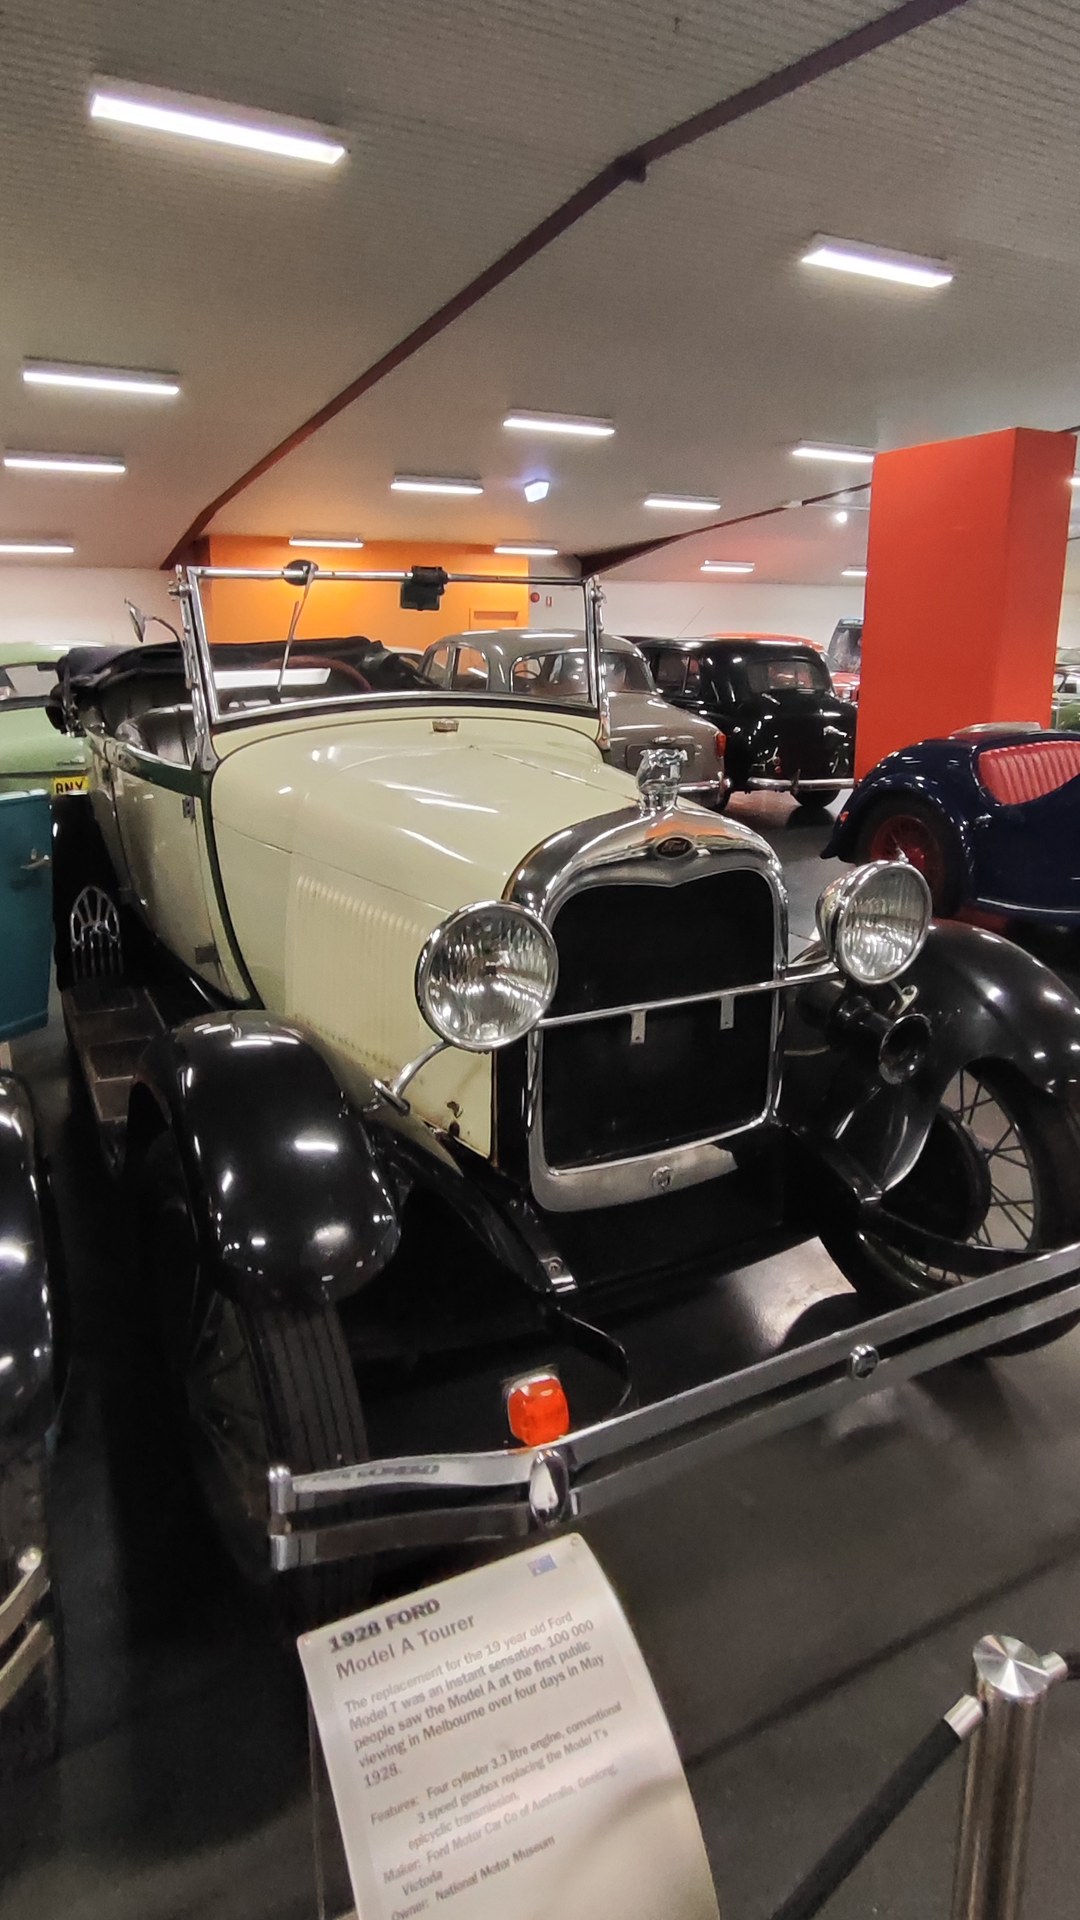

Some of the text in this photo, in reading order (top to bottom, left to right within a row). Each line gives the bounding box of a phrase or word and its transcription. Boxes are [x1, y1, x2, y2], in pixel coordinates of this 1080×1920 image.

[328, 1598, 440, 1653] 1928 FORD
[336, 1615, 474, 1680] Model A Tourer
[344, 1611, 573, 1713] The replacement for the 19 year old Ford
[349, 1620, 594, 1731] Model T was an instant sensation. 100 000
[354, 1641, 591, 1752] people saw the Model A at the first public
[359, 1654, 605, 1768] viewing in Melbourne over four days in May
[364, 1762, 402, 1787] 1928.
[370, 1700, 623, 1825] Features: Four cylinder 3.3 litre engine, conventional
[417, 1811, 426, 1824] 3
[427, 1796, 458, 1820] speed
[460, 1779, 499, 1807] gearbox
[501, 1756, 546, 1785] replacing
[546, 1749, 562, 1764] the
[563, 1733, 593, 1756] Model
[383, 1859, 421, 1884] Maker:
[427, 1843, 450, 1862] Ford
[452, 1829, 482, 1851] Motor
[484, 1820, 502, 1834] Car
[503, 1811, 518, 1825] Co
[520, 1803, 531, 1817] of
[408, 1821, 452, 1850] epicyclic
[435, 1870, 479, 1901] National
[479, 1858, 510, 1880] Motor
[512, 1835, 556, 1864] Museum
[402, 1870, 443, 1896] Victoria
